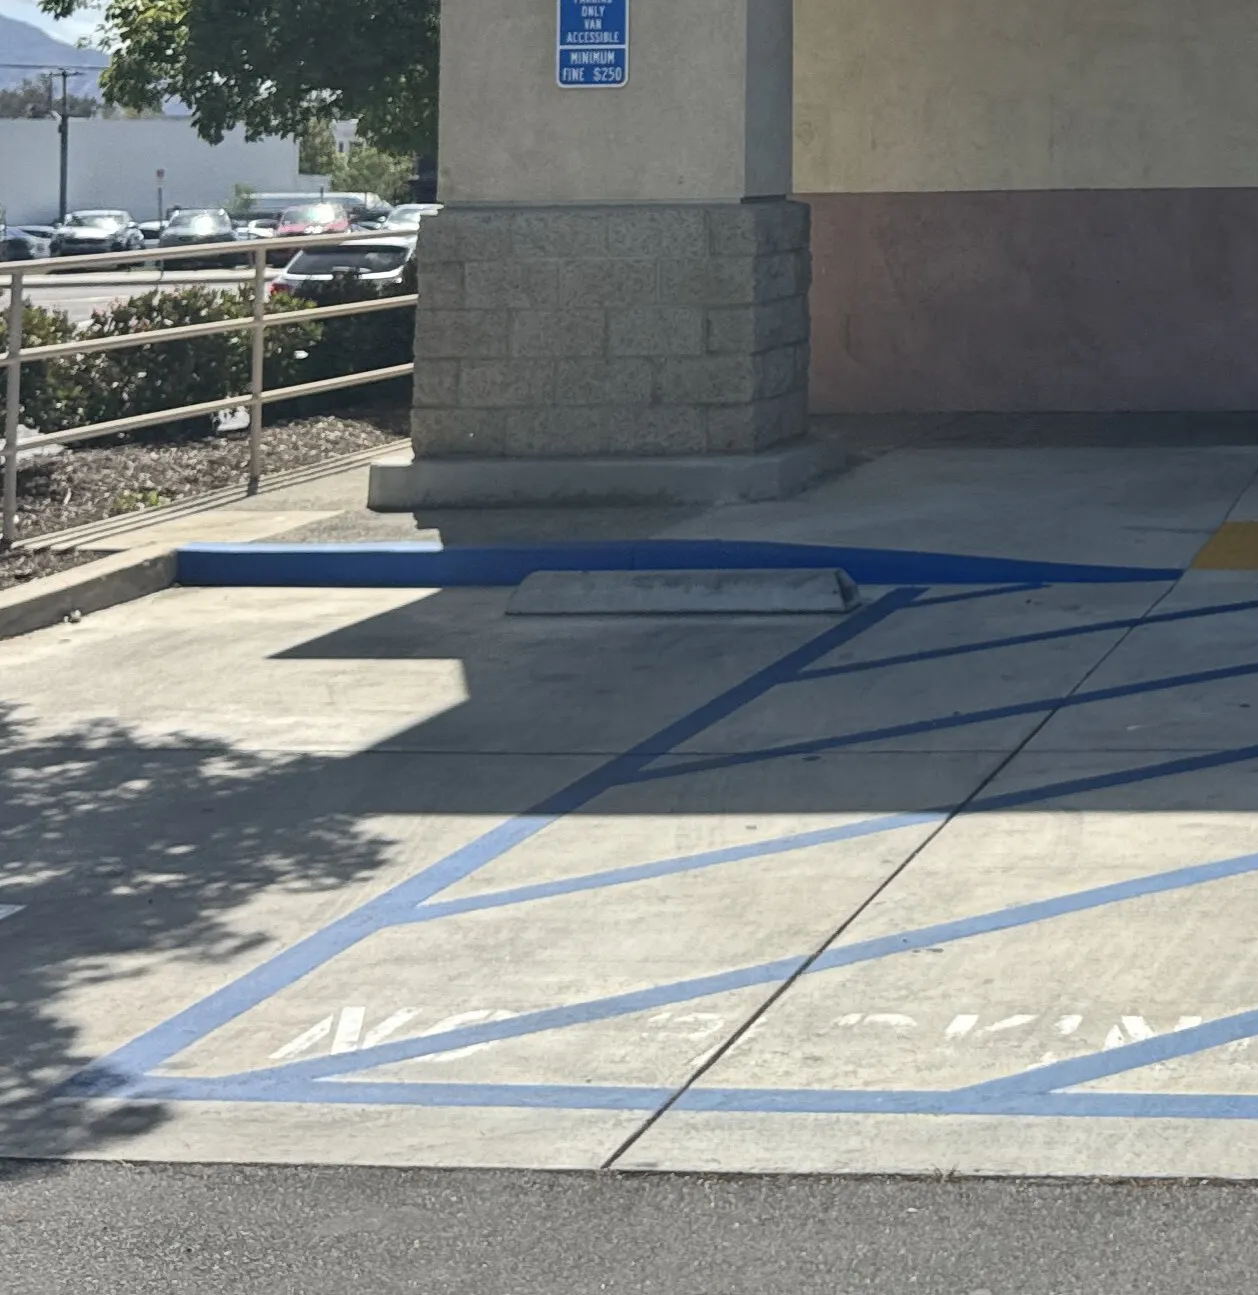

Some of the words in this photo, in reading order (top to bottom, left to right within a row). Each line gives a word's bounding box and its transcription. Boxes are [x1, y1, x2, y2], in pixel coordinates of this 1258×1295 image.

[581, 6, 606, 17] ONLY
[584, 19, 602, 30] VAN
[566, 31, 620, 43] ACCESSIBLE
[570, 51, 615, 65] MINIMUM
[562, 67, 585, 81] FINE
[593, 67, 622, 81] $250
[267, 1006, 520, 1062] NO
